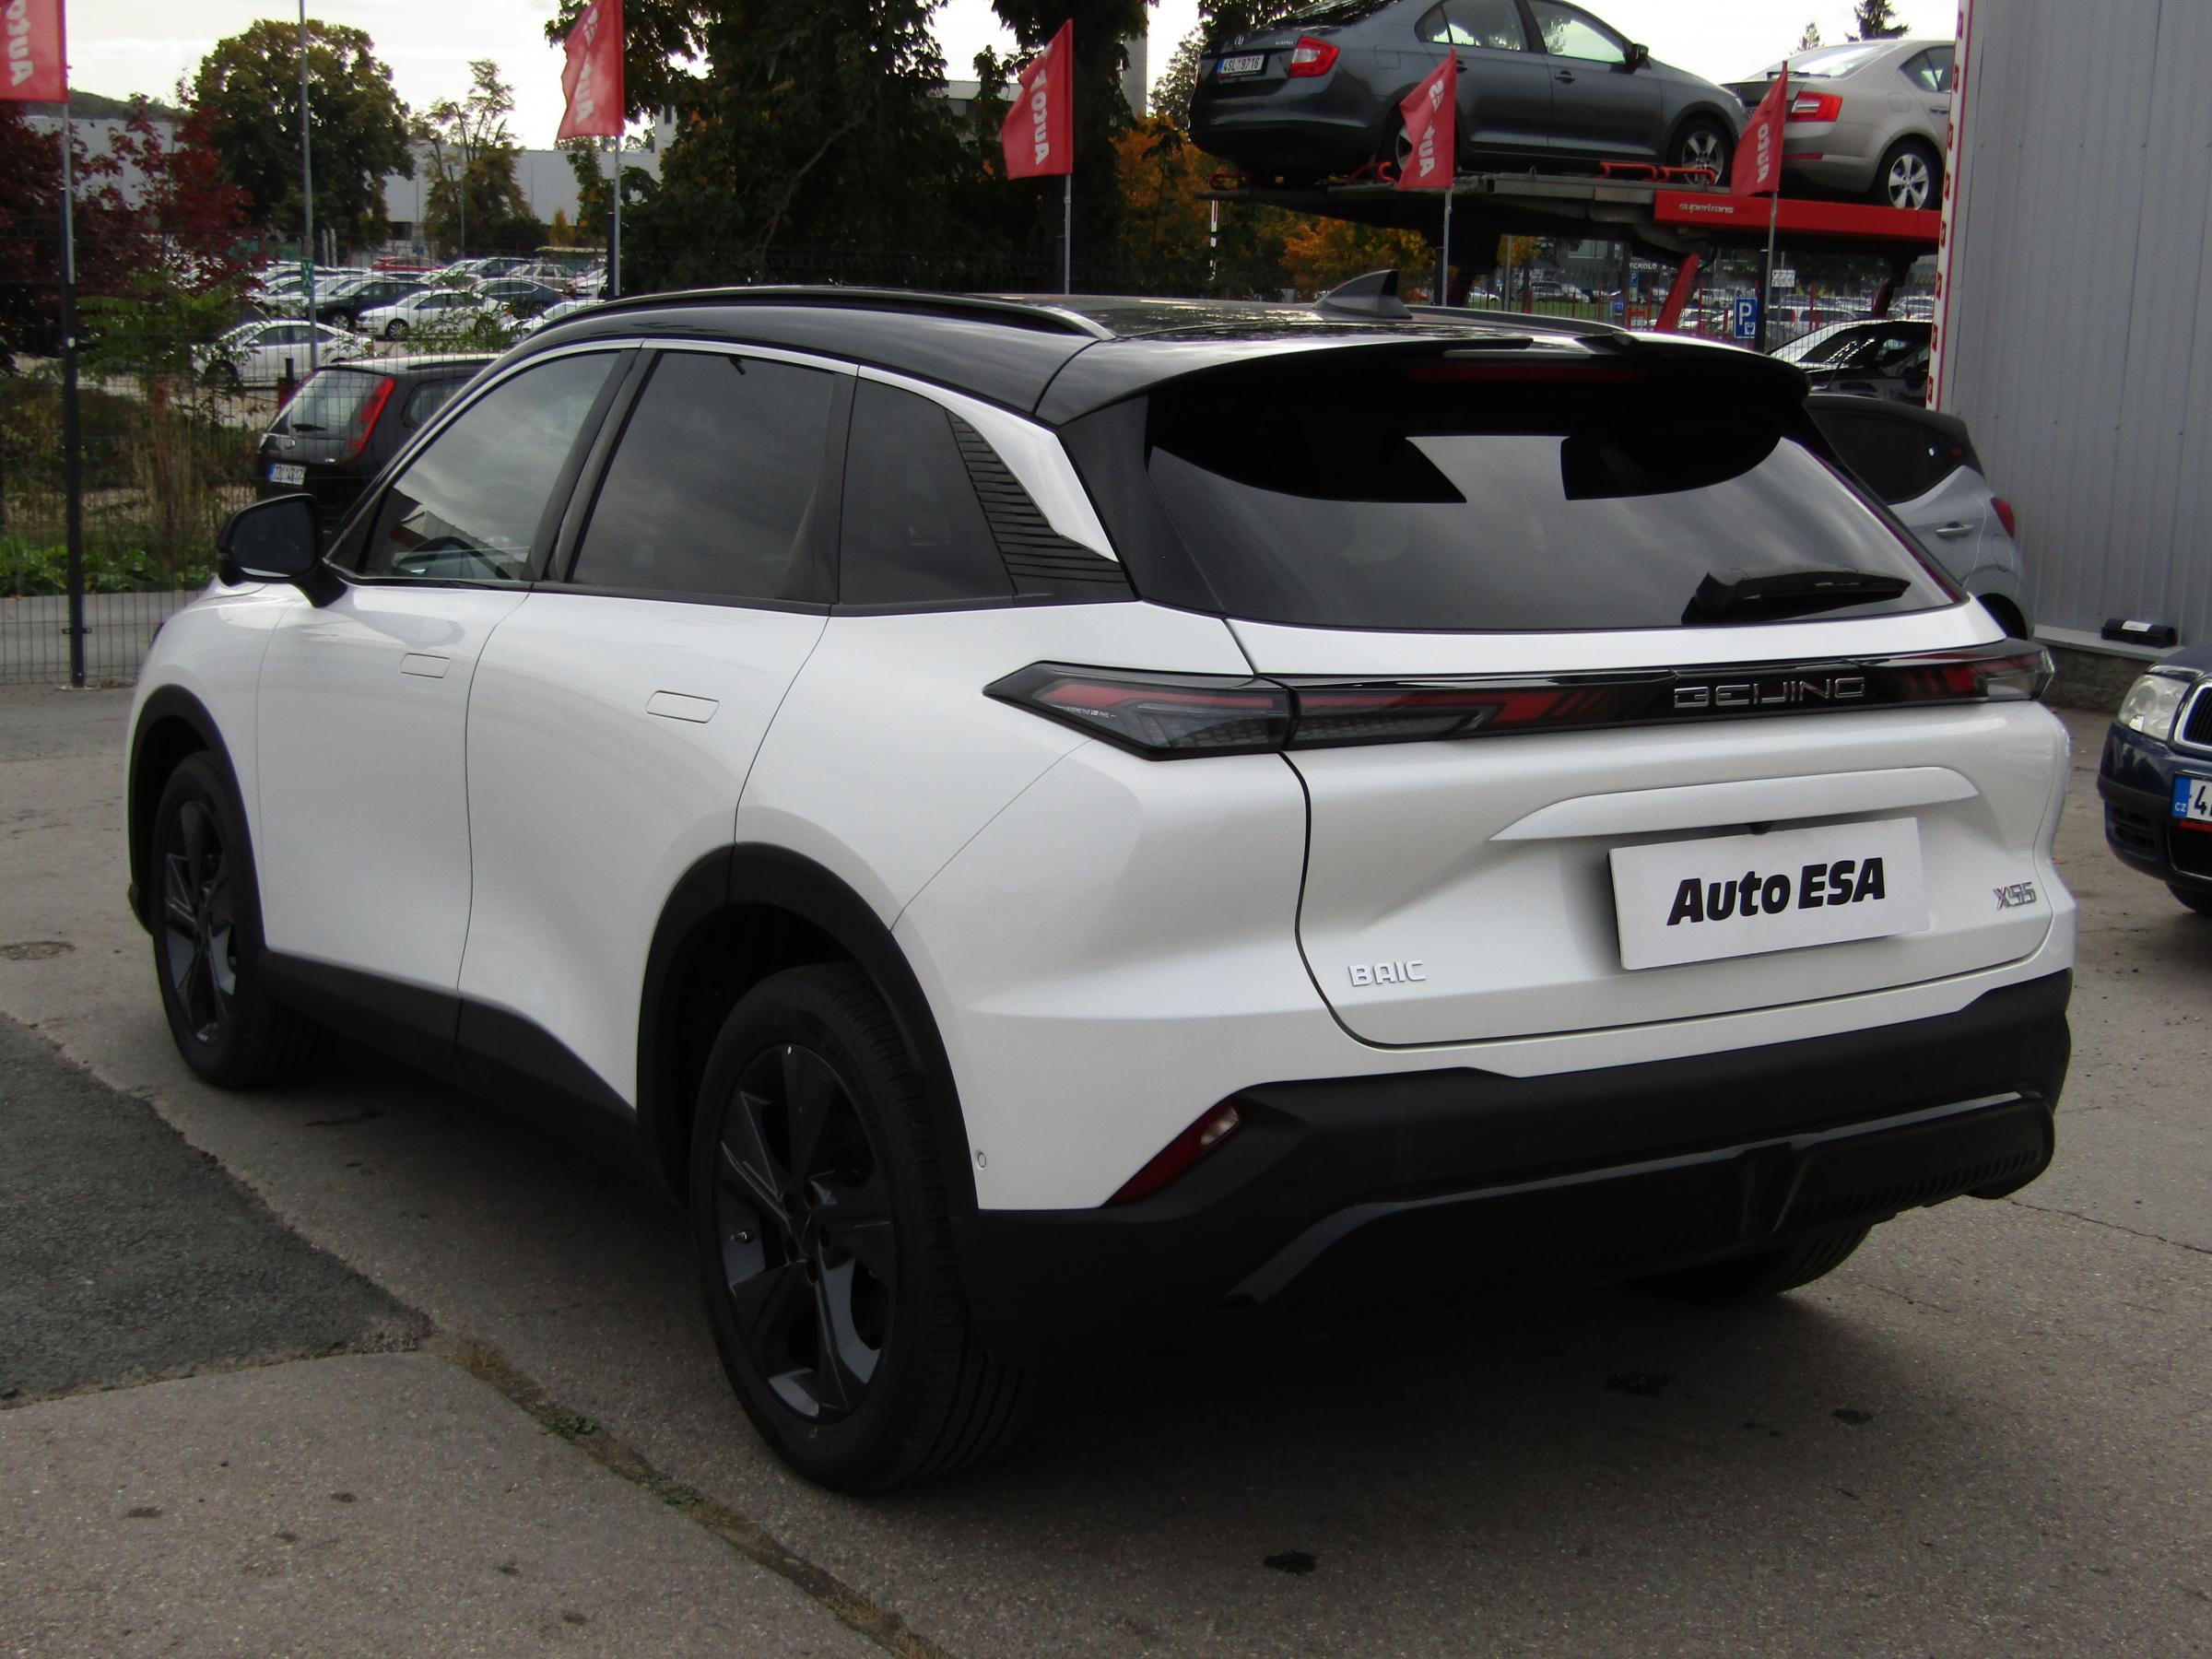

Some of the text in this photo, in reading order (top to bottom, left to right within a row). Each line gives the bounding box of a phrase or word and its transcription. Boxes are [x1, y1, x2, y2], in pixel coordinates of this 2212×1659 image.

[1738, 301, 1753, 325] P
[2175, 802, 2187, 813] CZ
[2194, 785, 2212, 817] 4
[1666, 857, 1886, 926] Auto ESA
[1992, 881, 2037, 911] X55
[1348, 959, 1428, 987] BAIC
